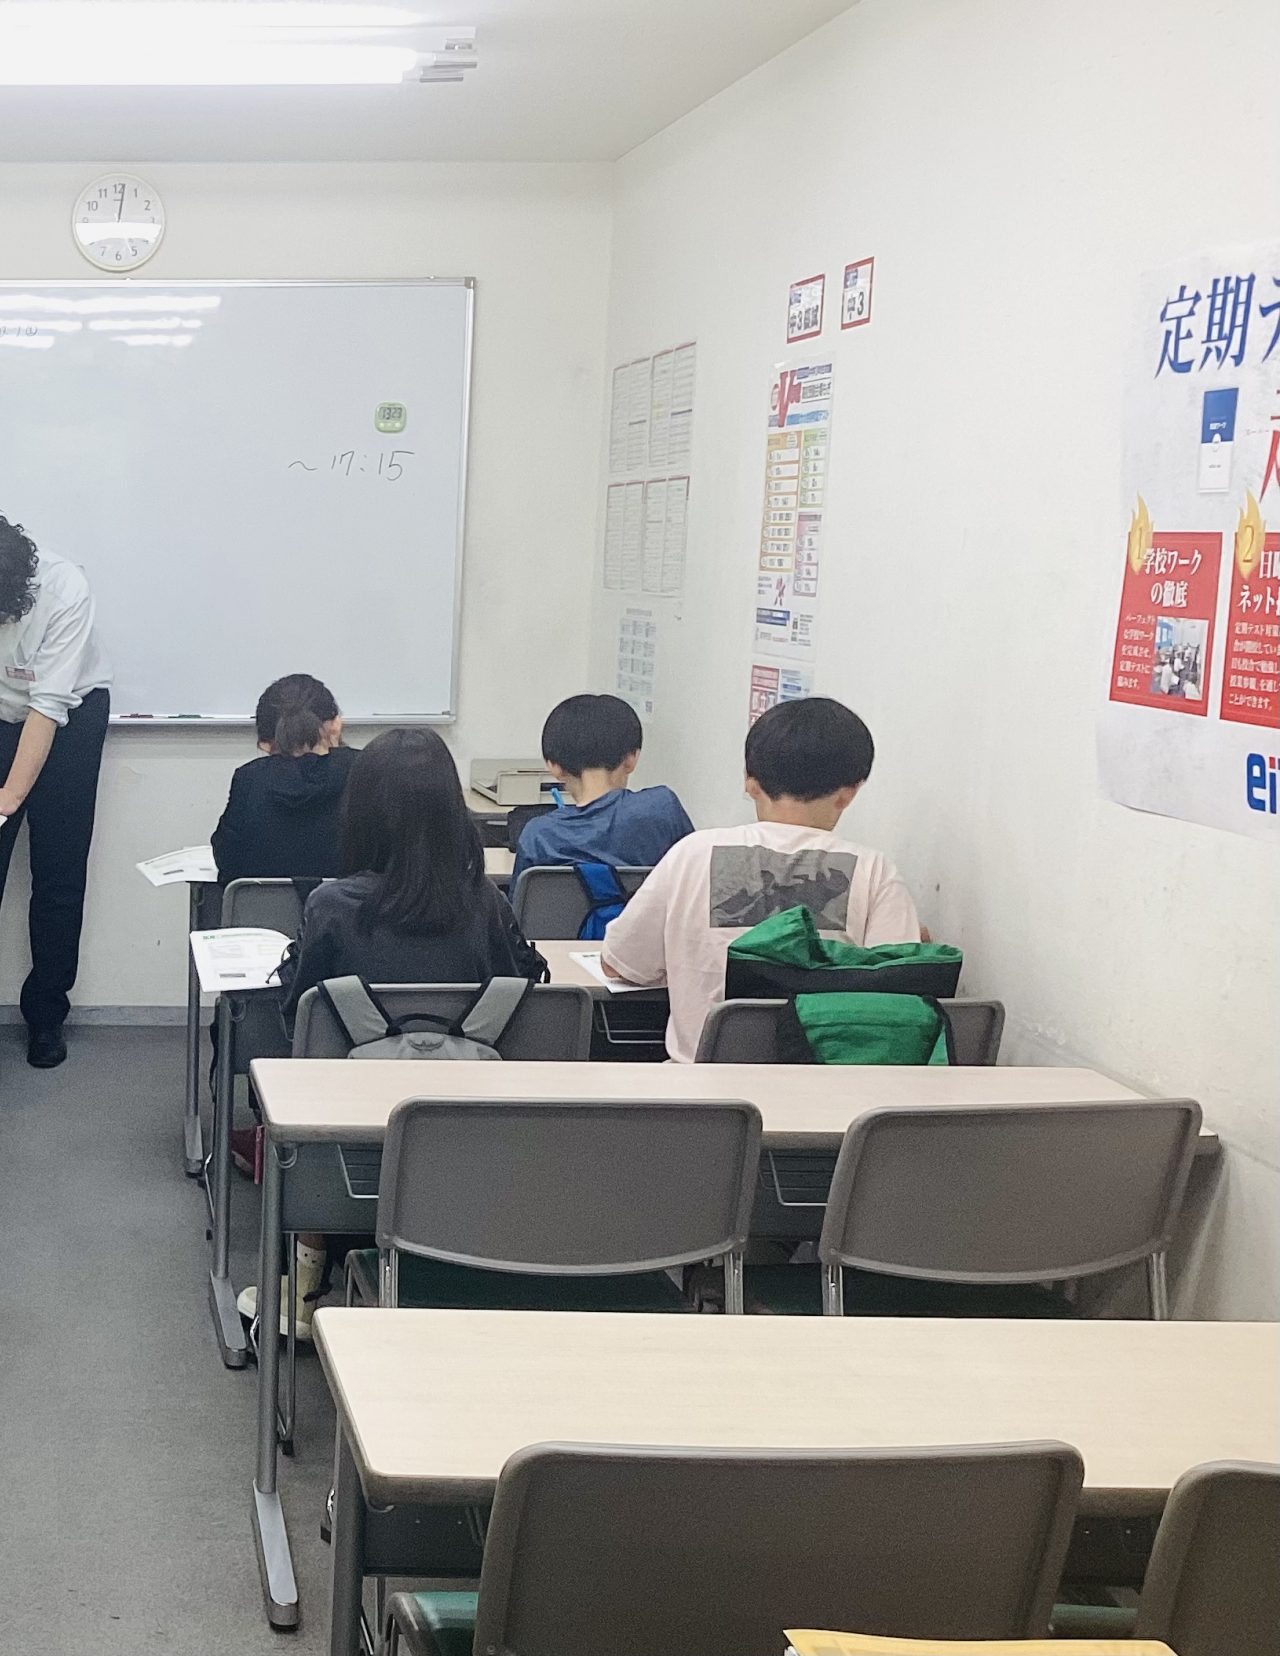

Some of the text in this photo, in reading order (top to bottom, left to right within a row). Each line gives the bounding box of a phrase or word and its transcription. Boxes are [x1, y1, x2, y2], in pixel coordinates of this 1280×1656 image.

[98, 188, 108, 198] 11
[133, 187, 138, 198] 1
[87, 201, 98, 211] 10
[144, 200, 151, 211] 2
[100, 247, 107, 257] 7
[115, 251, 122, 261] 6
[131, 246, 138, 257] 5
[1242, 525, 1254, 562] 2
[1143, 547, 1202, 575] 学校ワーク
[1236, 584, 1280, 616] ネット
